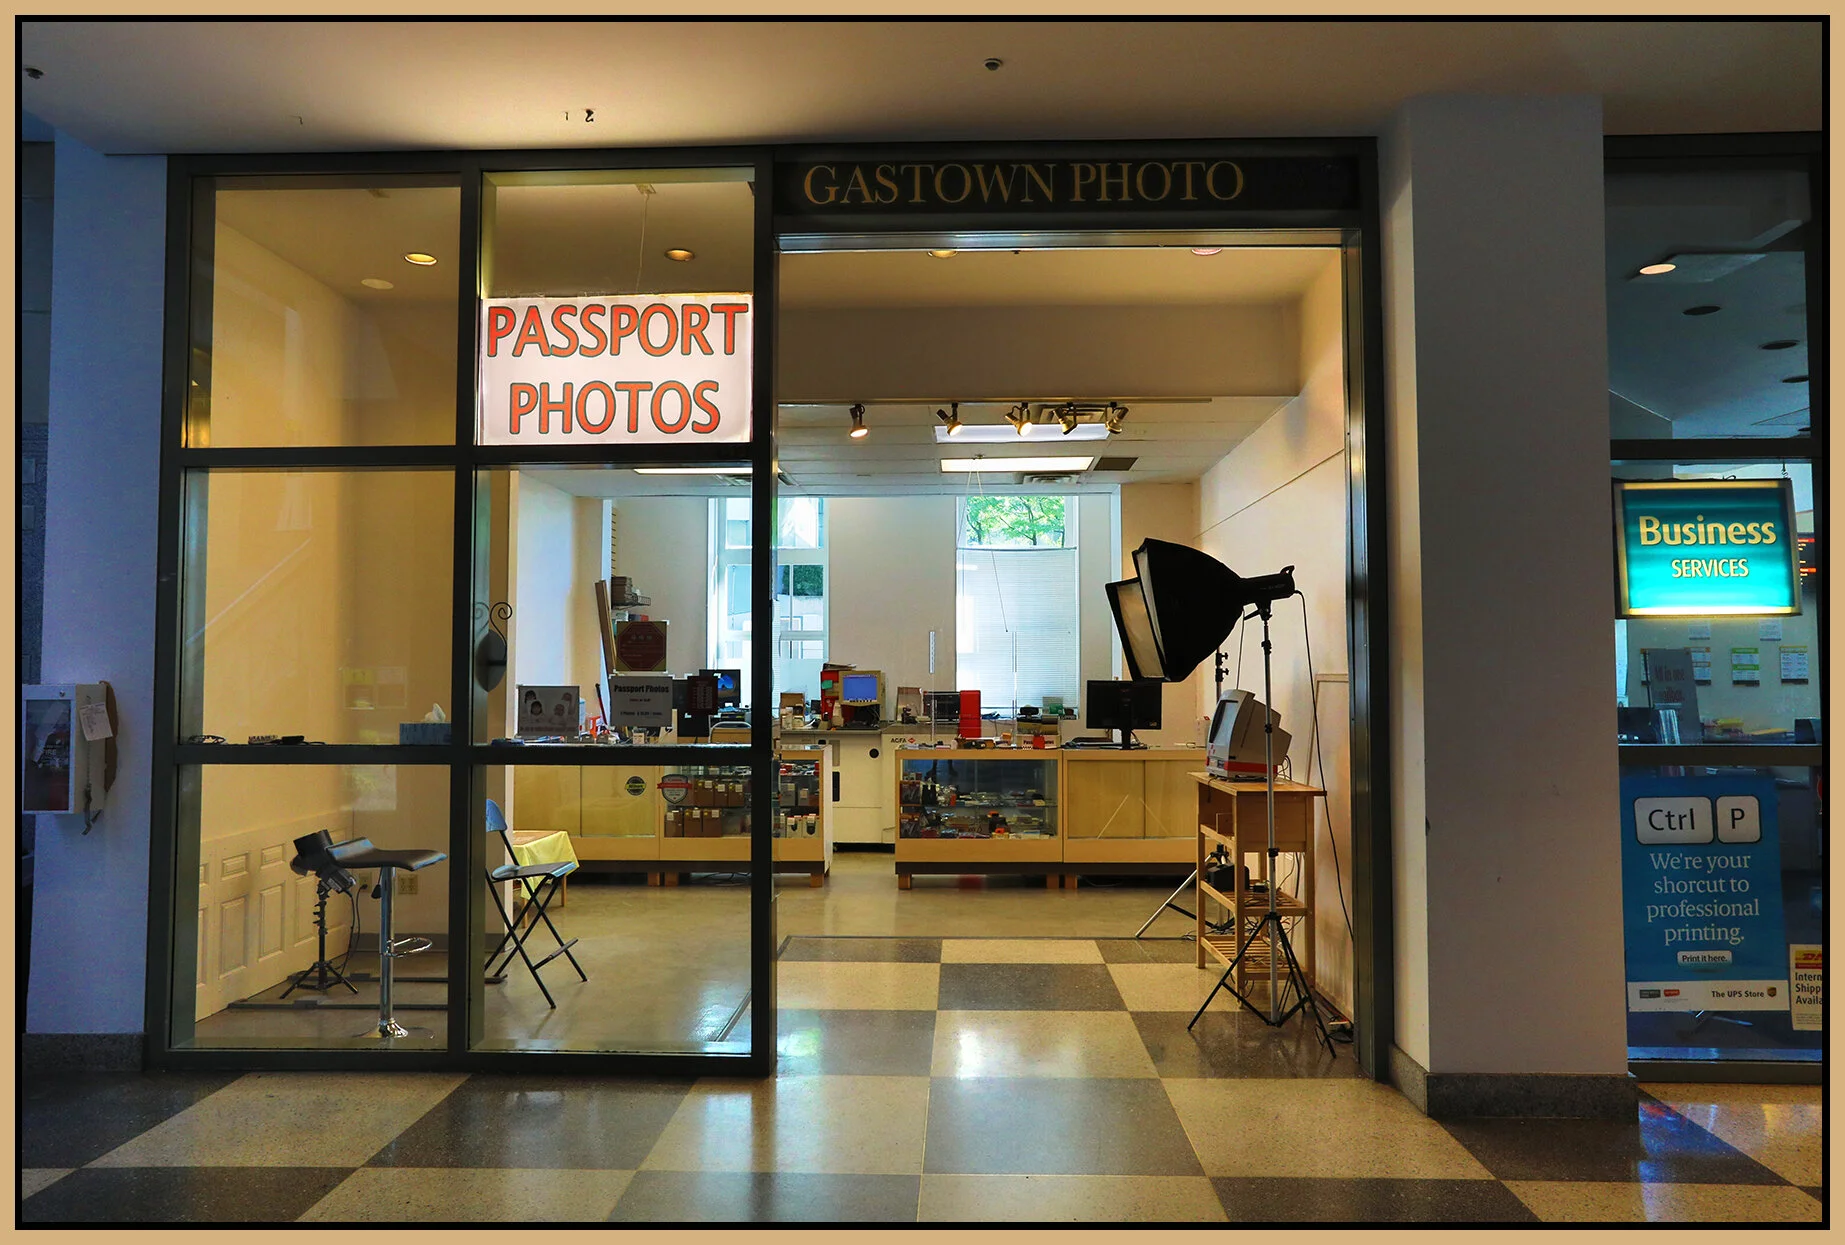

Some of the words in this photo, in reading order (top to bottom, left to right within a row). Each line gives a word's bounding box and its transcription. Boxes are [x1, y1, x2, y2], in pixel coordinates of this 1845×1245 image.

[803, 162, 1055, 205] GASTOWN
[1069, 161, 1245, 203] PHOTO
[487, 303, 748, 358] PASSPORT
[509, 380, 721, 434] PHOTOS
[1639, 514, 1777, 546] Business
[1671, 558, 1749, 578] SERVICES
[614, 685, 644, 693] Passport
[645, 685, 669, 693] Photos
[1648, 808, 1695, 831] Ctrl
[1731, 808, 1745, 829] P
[1650, 853, 1702, 870] We're
[1706, 854, 1751, 874] your
[1654, 876, 1727, 894] shorcut
[1730, 878, 1750, 893] to
[1646, 899, 1760, 923] professional
[1664, 924, 1744, 946] printing.
[1682, 955, 1700, 963] Print
[1701, 954, 1707, 962] it
[1708, 954, 1728, 962] here.
[1711, 990, 1726, 998] The
[1727, 990, 1742, 998] UPS
[1745, 990, 1764, 998] Store
